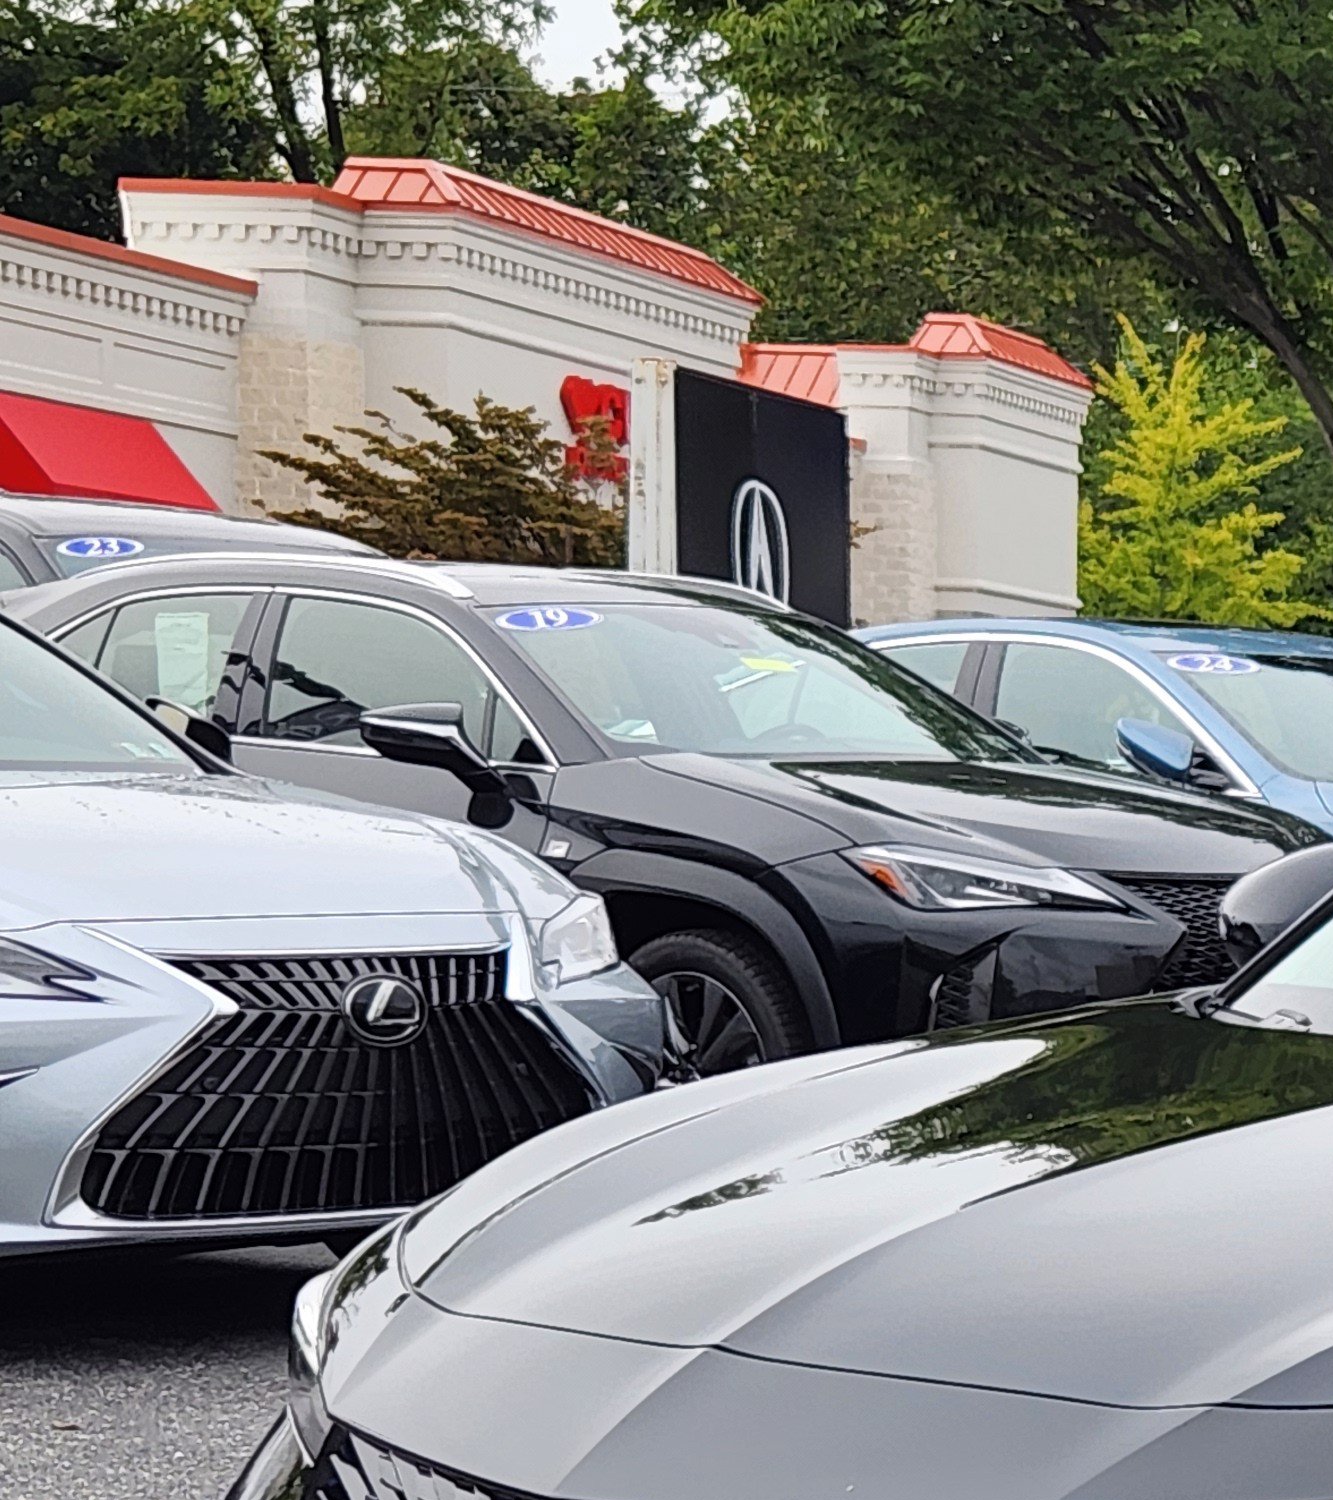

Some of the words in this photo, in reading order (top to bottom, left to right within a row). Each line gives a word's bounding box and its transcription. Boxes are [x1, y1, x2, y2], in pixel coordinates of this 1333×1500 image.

[83, 538, 121, 557] 23
[526, 608, 569, 629] 19
[1194, 655, 1234, 672] 24
